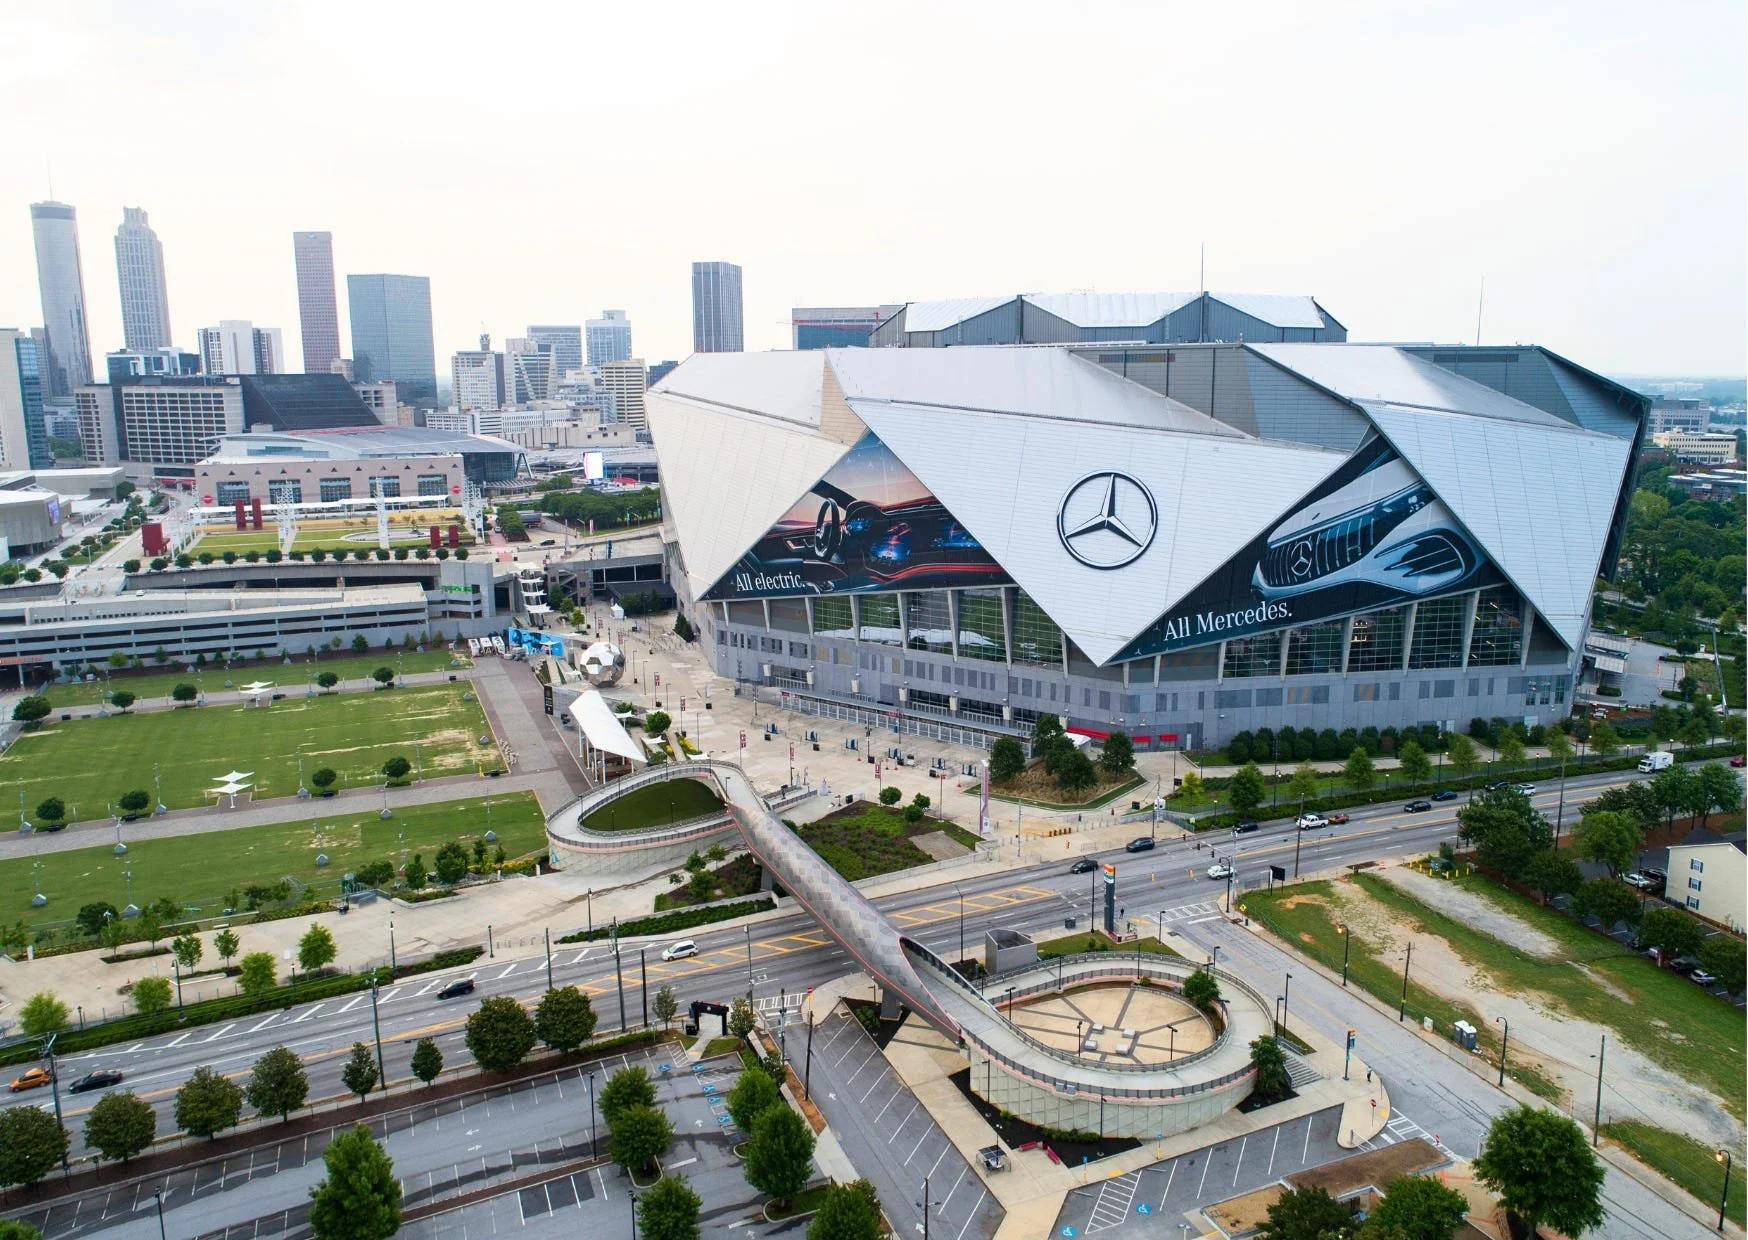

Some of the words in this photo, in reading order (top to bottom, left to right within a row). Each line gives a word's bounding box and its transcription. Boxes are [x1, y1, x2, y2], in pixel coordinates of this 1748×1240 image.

[736, 573, 753, 591] All
[755, 571, 806, 590] electric.
[1163, 616, 1191, 641] All
[1196, 600, 1293, 635] Mercedes.
